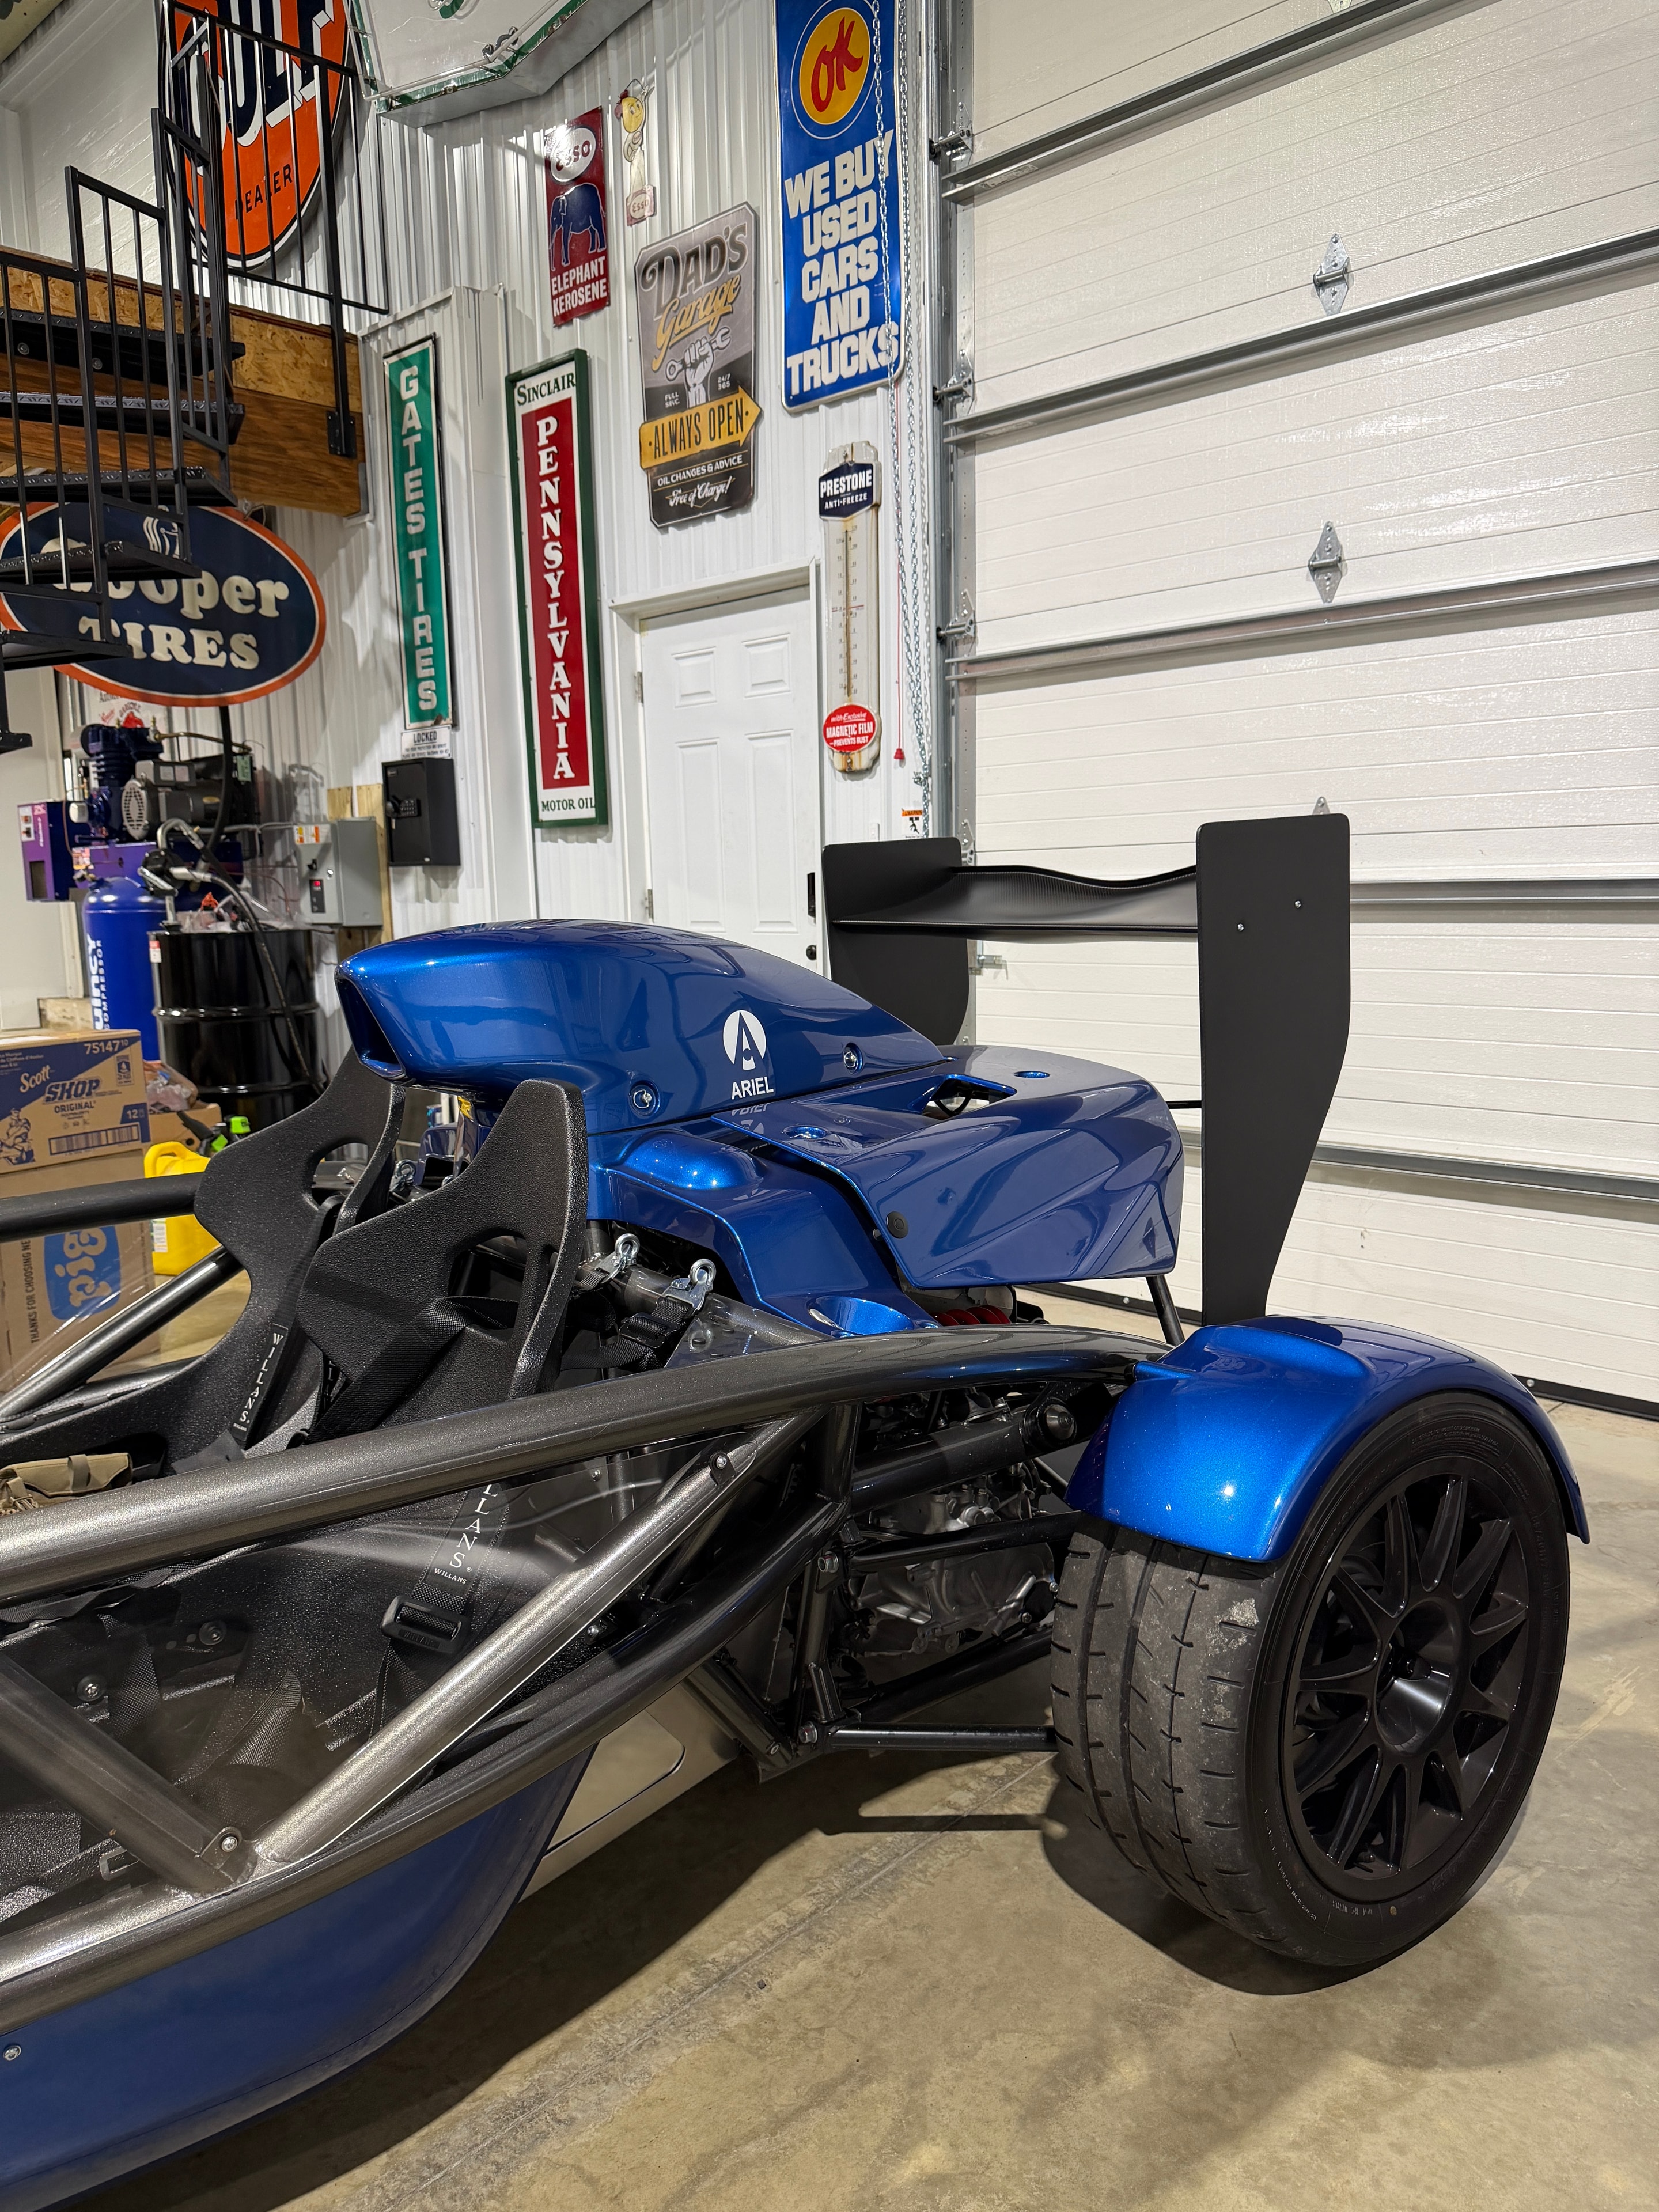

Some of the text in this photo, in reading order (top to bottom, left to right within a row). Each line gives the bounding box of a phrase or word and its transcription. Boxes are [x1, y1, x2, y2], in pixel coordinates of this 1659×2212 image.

[810, 16, 864, 112] OK
[784, 129, 894, 219] WE BUY
[234, 164, 293, 220] EAER
[802, 188, 877, 257] USED
[551, 255, 606, 296] ELEPHANT
[641, 222, 748, 321] DAD'S
[801, 236, 878, 304] CARS
[552, 278, 607, 317] KEROSENE
[652, 274, 742, 372] Garage
[810, 285, 870, 346] AND
[786, 321, 899, 396] TRUCKS
[717, 373, 731, 384] 24/7
[717, 381, 731, 391] 365
[664, 392, 679, 402] FULL
[653, 397, 744, 459] ALWAYS OPEN
[400, 365, 425, 536] GATES
[657, 454, 743, 487] OIL CHANGES & ADVICE
[820, 469, 873, 498] PRESTONE
[669, 475, 733, 508] Free of Charge!
[824, 493, 868, 510] ANTI-FREEZE
[536, 415, 575, 780] PENNSYLVANIA
[78, 614, 260, 671] TIRES
[408, 547, 438, 711] TIRES
[413, 730, 437, 744] LOCKED
[826, 721, 873, 738] MAGNETIC FILM
[857, 735, 869, 745] RUST
[541, 797, 596, 812] MOTOR OIL
[84, 1040, 120, 1055] 75147
[20, 1064, 51, 1093] Scott
[45, 1079, 100, 1103] SHOP
[731, 1076, 774, 1100] ARIEL
[54, 1101, 94, 1113] ORIGINAL
[127, 1109, 138, 1119] 12
[21, 1238, 40, 1344] THANKS FOR CHOOSING NE
[434, 1567, 468, 1585] WILLANS
